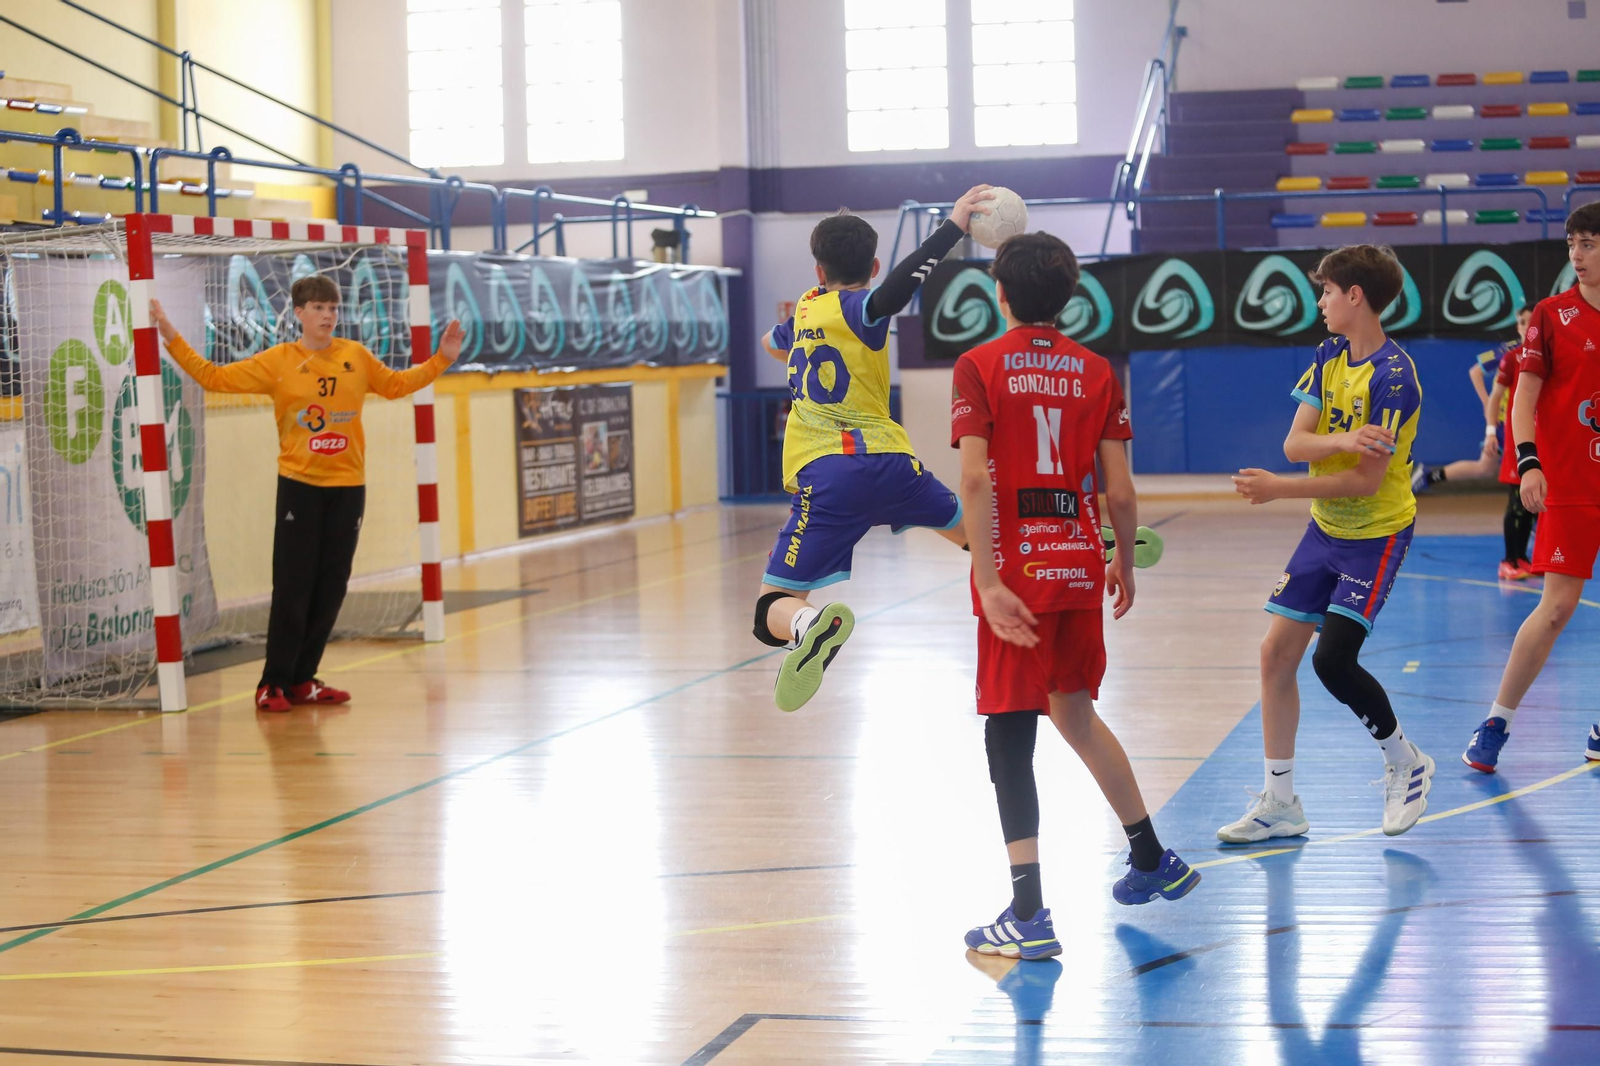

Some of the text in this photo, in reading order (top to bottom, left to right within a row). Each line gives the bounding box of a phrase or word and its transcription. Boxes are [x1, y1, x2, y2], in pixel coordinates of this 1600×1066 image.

[1032, 338, 1052, 347] CBM
[1003, 352, 1085, 374] IGLUVAN
[318, 376, 337, 397] 37
[1008, 374, 1086, 398] GONZALO G.
[1022, 492, 1077, 516] STILOTEX
[784, 535, 801, 568] BM
[1038, 543, 1050, 551] LA
[1051, 542, 1094, 551] CARIHUELA
[1036, 567, 1088, 580] PETROIL
[1068, 580, 1094, 589] energy
